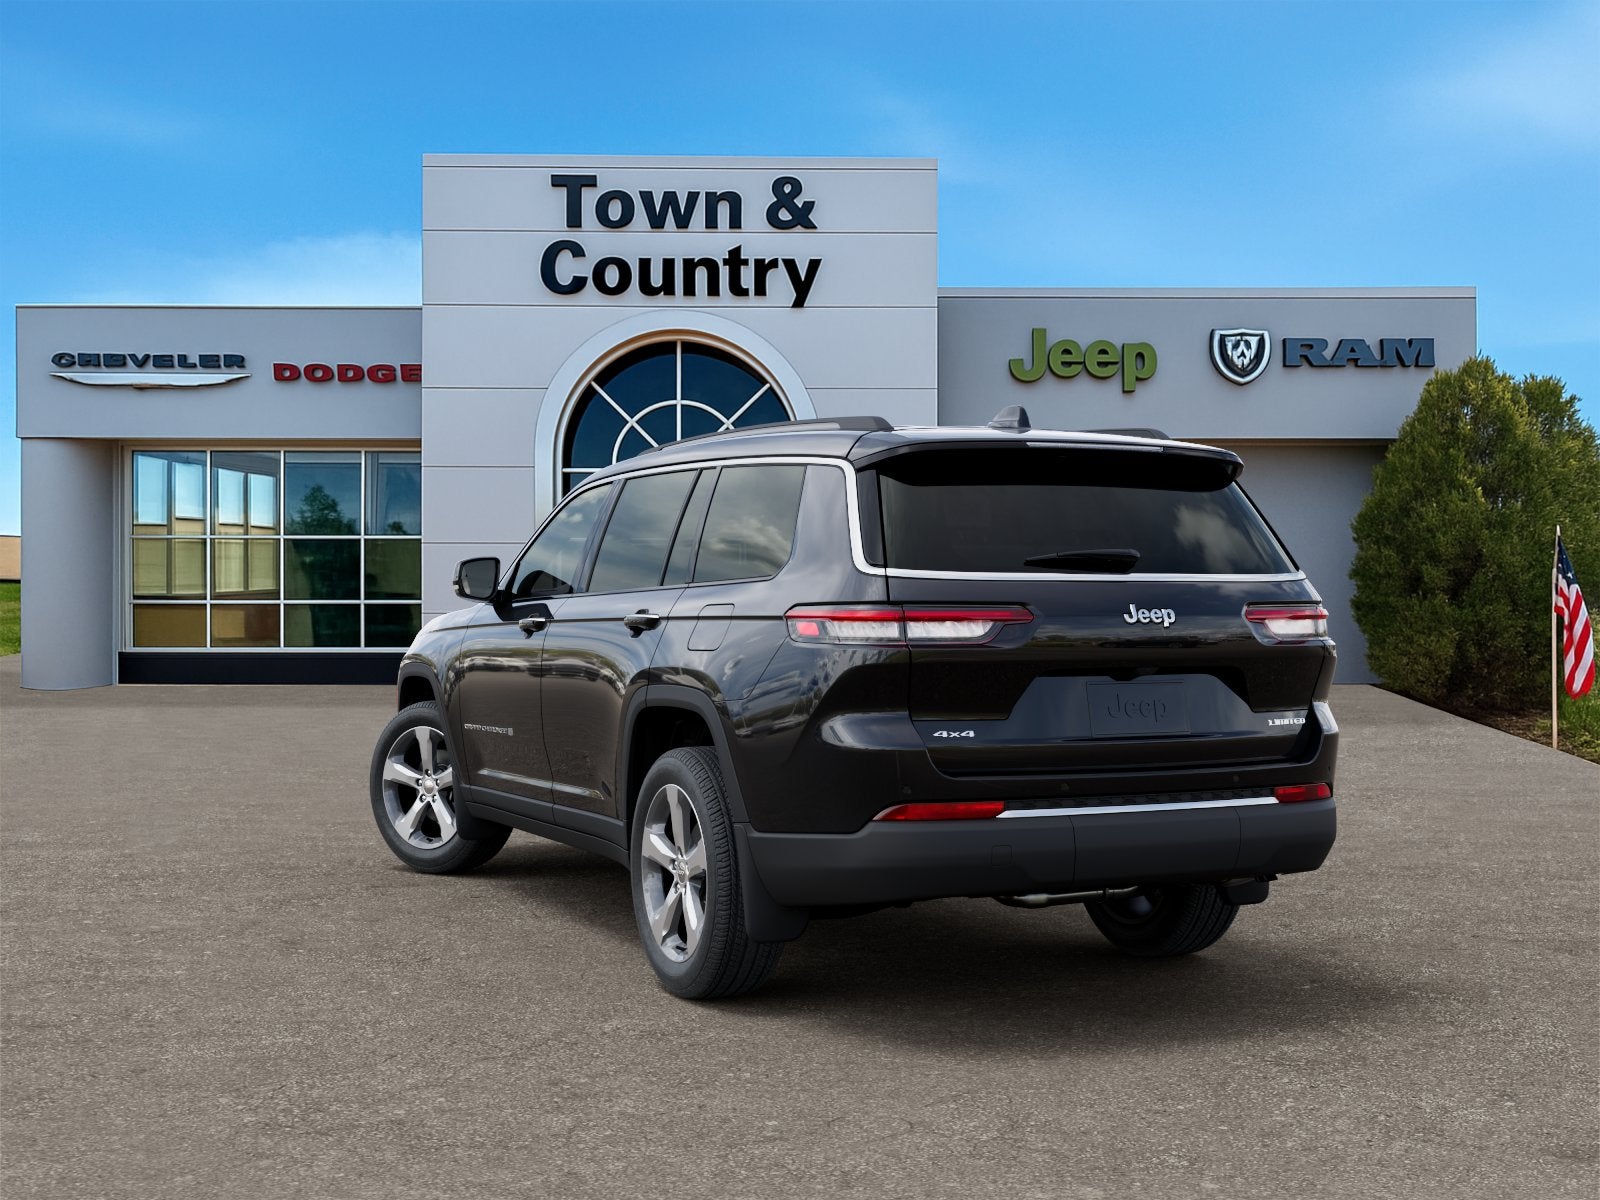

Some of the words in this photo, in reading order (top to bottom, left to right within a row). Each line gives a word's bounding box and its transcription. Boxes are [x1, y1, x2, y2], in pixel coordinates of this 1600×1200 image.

[550, 174, 742, 230] Town
[765, 176, 818, 230] &
[540, 239, 822, 308] Country
[1009, 328, 1157, 392] Jeep
[1282, 337, 1435, 368] RAM
[273, 363, 422, 383] DODGE
[1123, 603, 1176, 627] Jeep
[1107, 691, 1166, 723] Jeep
[933, 730, 975, 738] 4x4
